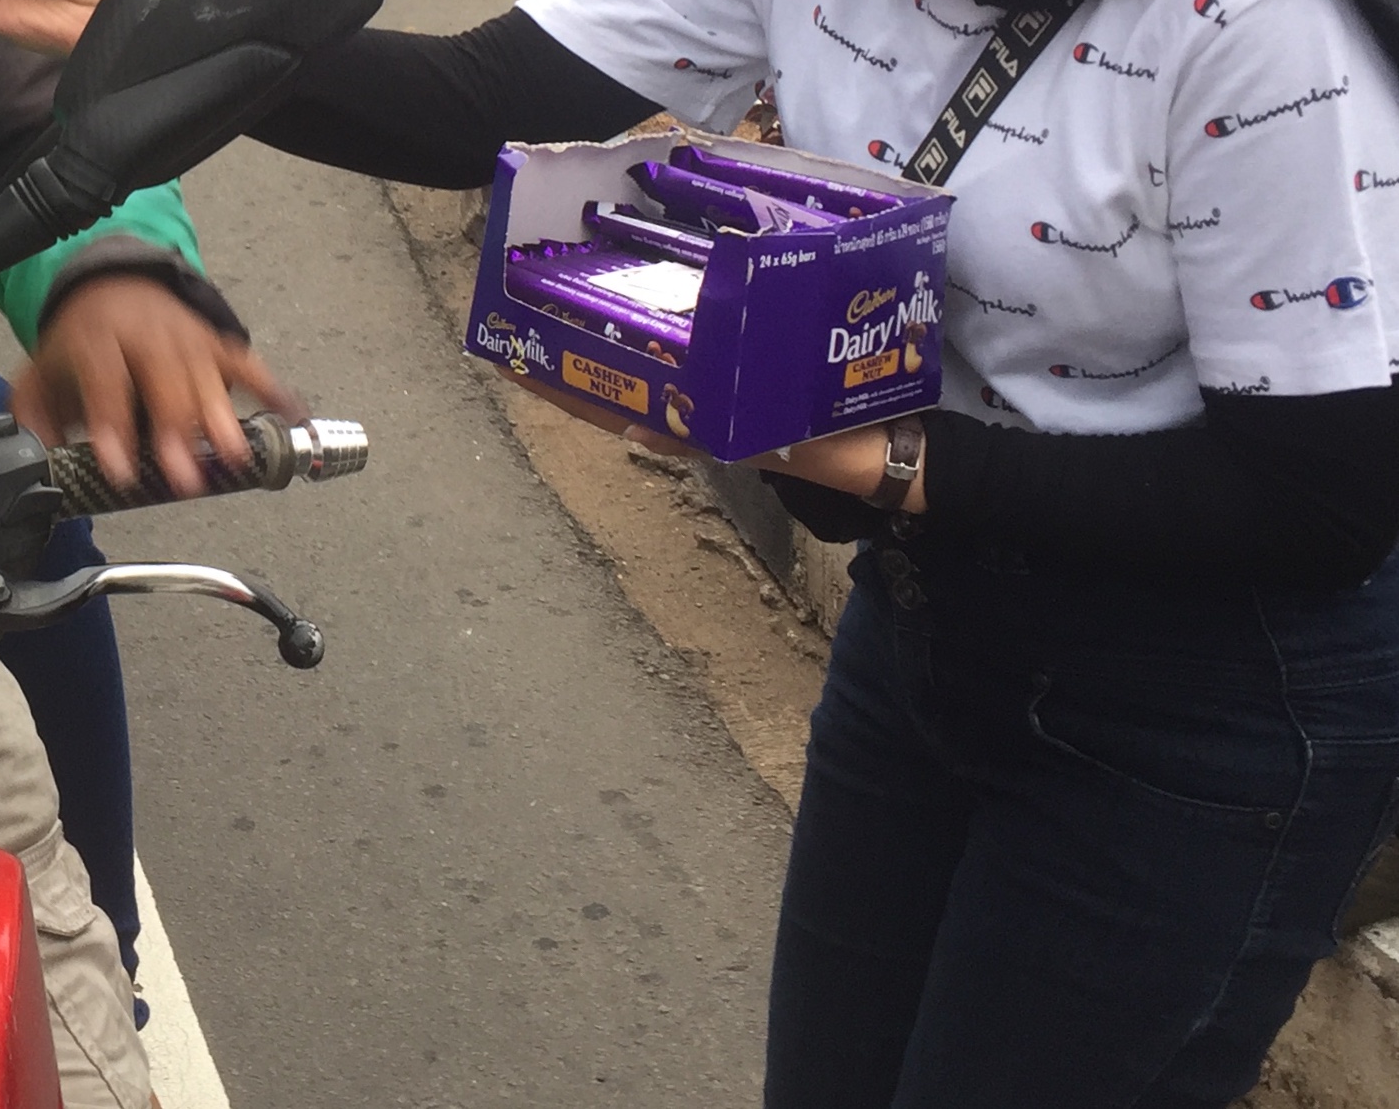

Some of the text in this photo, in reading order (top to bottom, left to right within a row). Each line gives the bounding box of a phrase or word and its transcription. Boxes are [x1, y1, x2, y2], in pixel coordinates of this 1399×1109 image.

[989, 38, 1018, 78] FILA
[942, 107, 967, 148] FILA
[1205, 81, 1349, 139] Champion
[1031, 214, 1141, 258] Champion
[476, 322, 515, 360] Dairy
[827, 288, 939, 363] Dairy Milk
[572, 357, 638, 393] CASHEW
[852, 353, 893, 374] CASHEW
[861, 367, 883, 381] NUT
[590, 378, 623, 402] NUT
